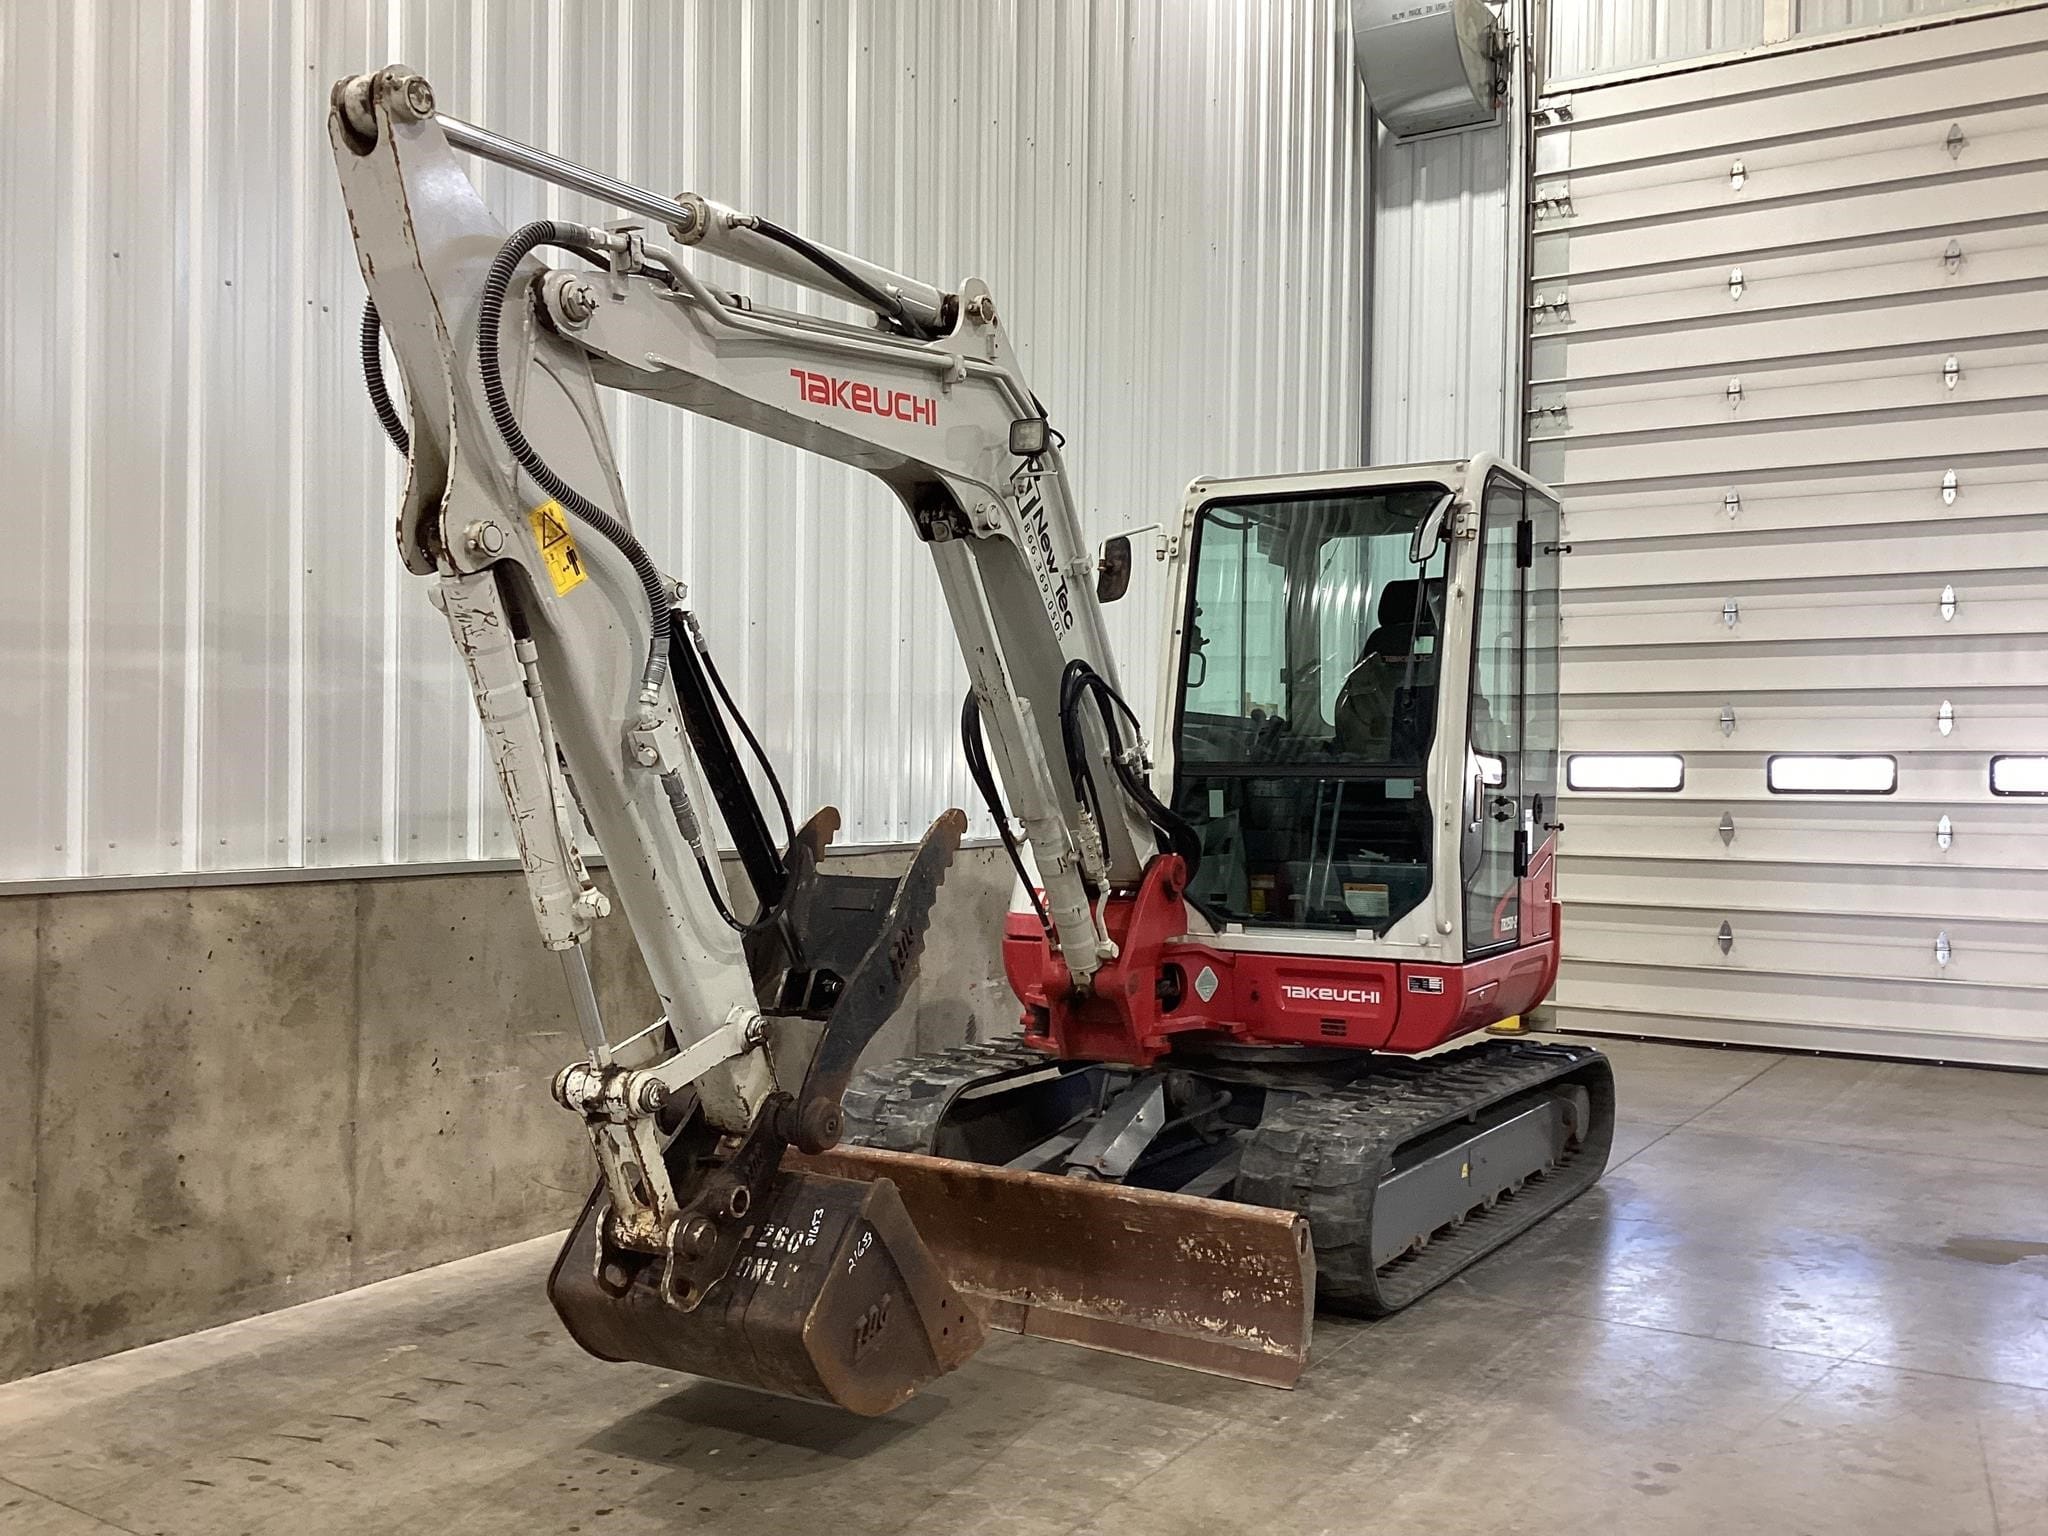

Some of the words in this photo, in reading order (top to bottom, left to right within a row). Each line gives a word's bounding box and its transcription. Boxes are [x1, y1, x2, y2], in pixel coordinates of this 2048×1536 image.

[1023, 522, 1064, 642] 866.369.0505
[1033, 505, 1059, 575] New
[1055, 574, 1074, 631] Tec
[1281, 985, 1381, 1004] TAKEUCHI
